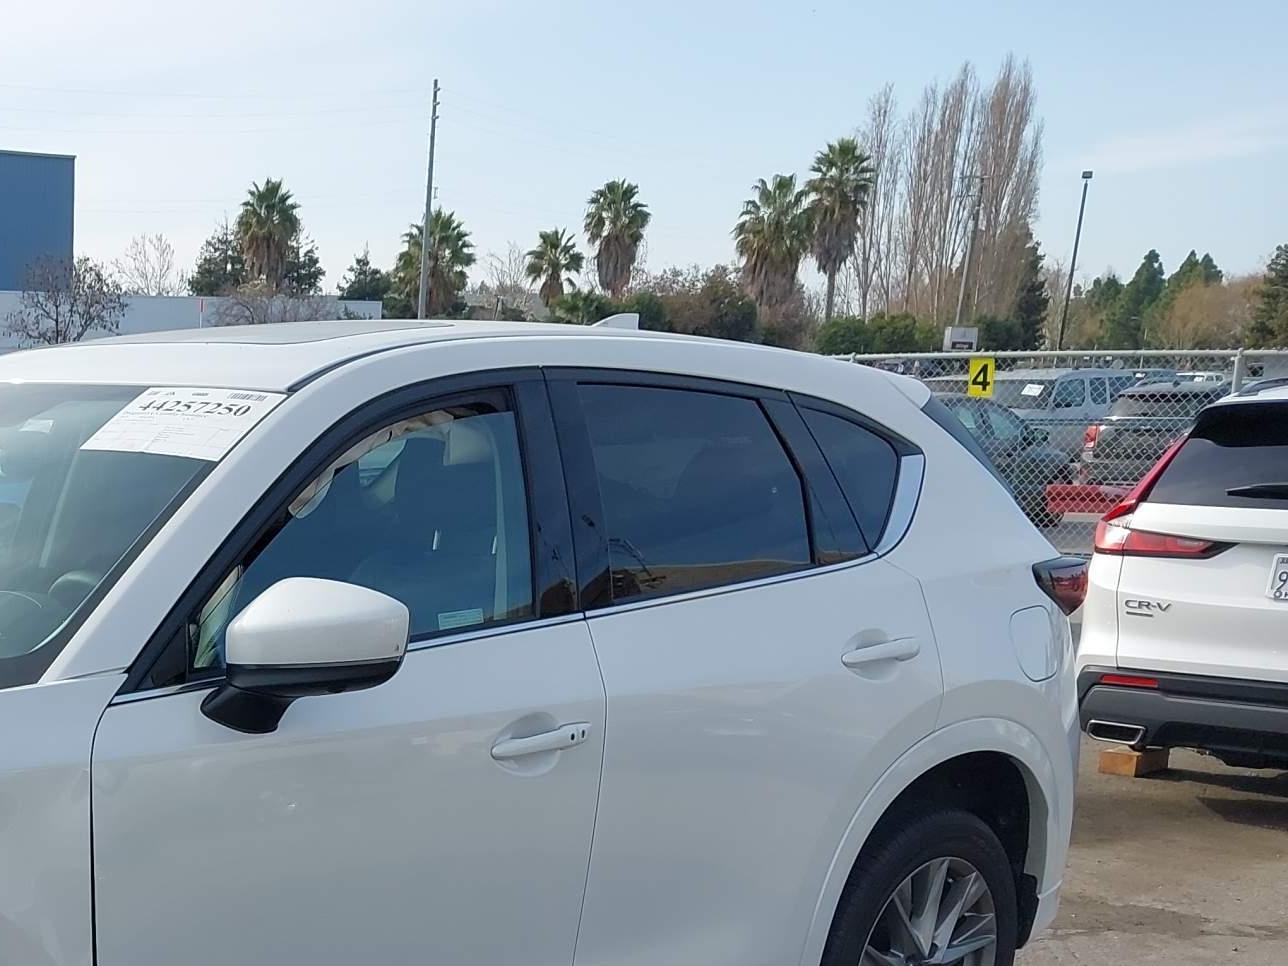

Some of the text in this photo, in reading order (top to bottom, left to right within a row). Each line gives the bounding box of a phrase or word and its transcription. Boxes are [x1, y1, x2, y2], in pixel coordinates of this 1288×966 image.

[972, 363, 990, 391] 4
[138, 399, 252, 417] 44257250
[1125, 599, 1172, 612] CR-V
